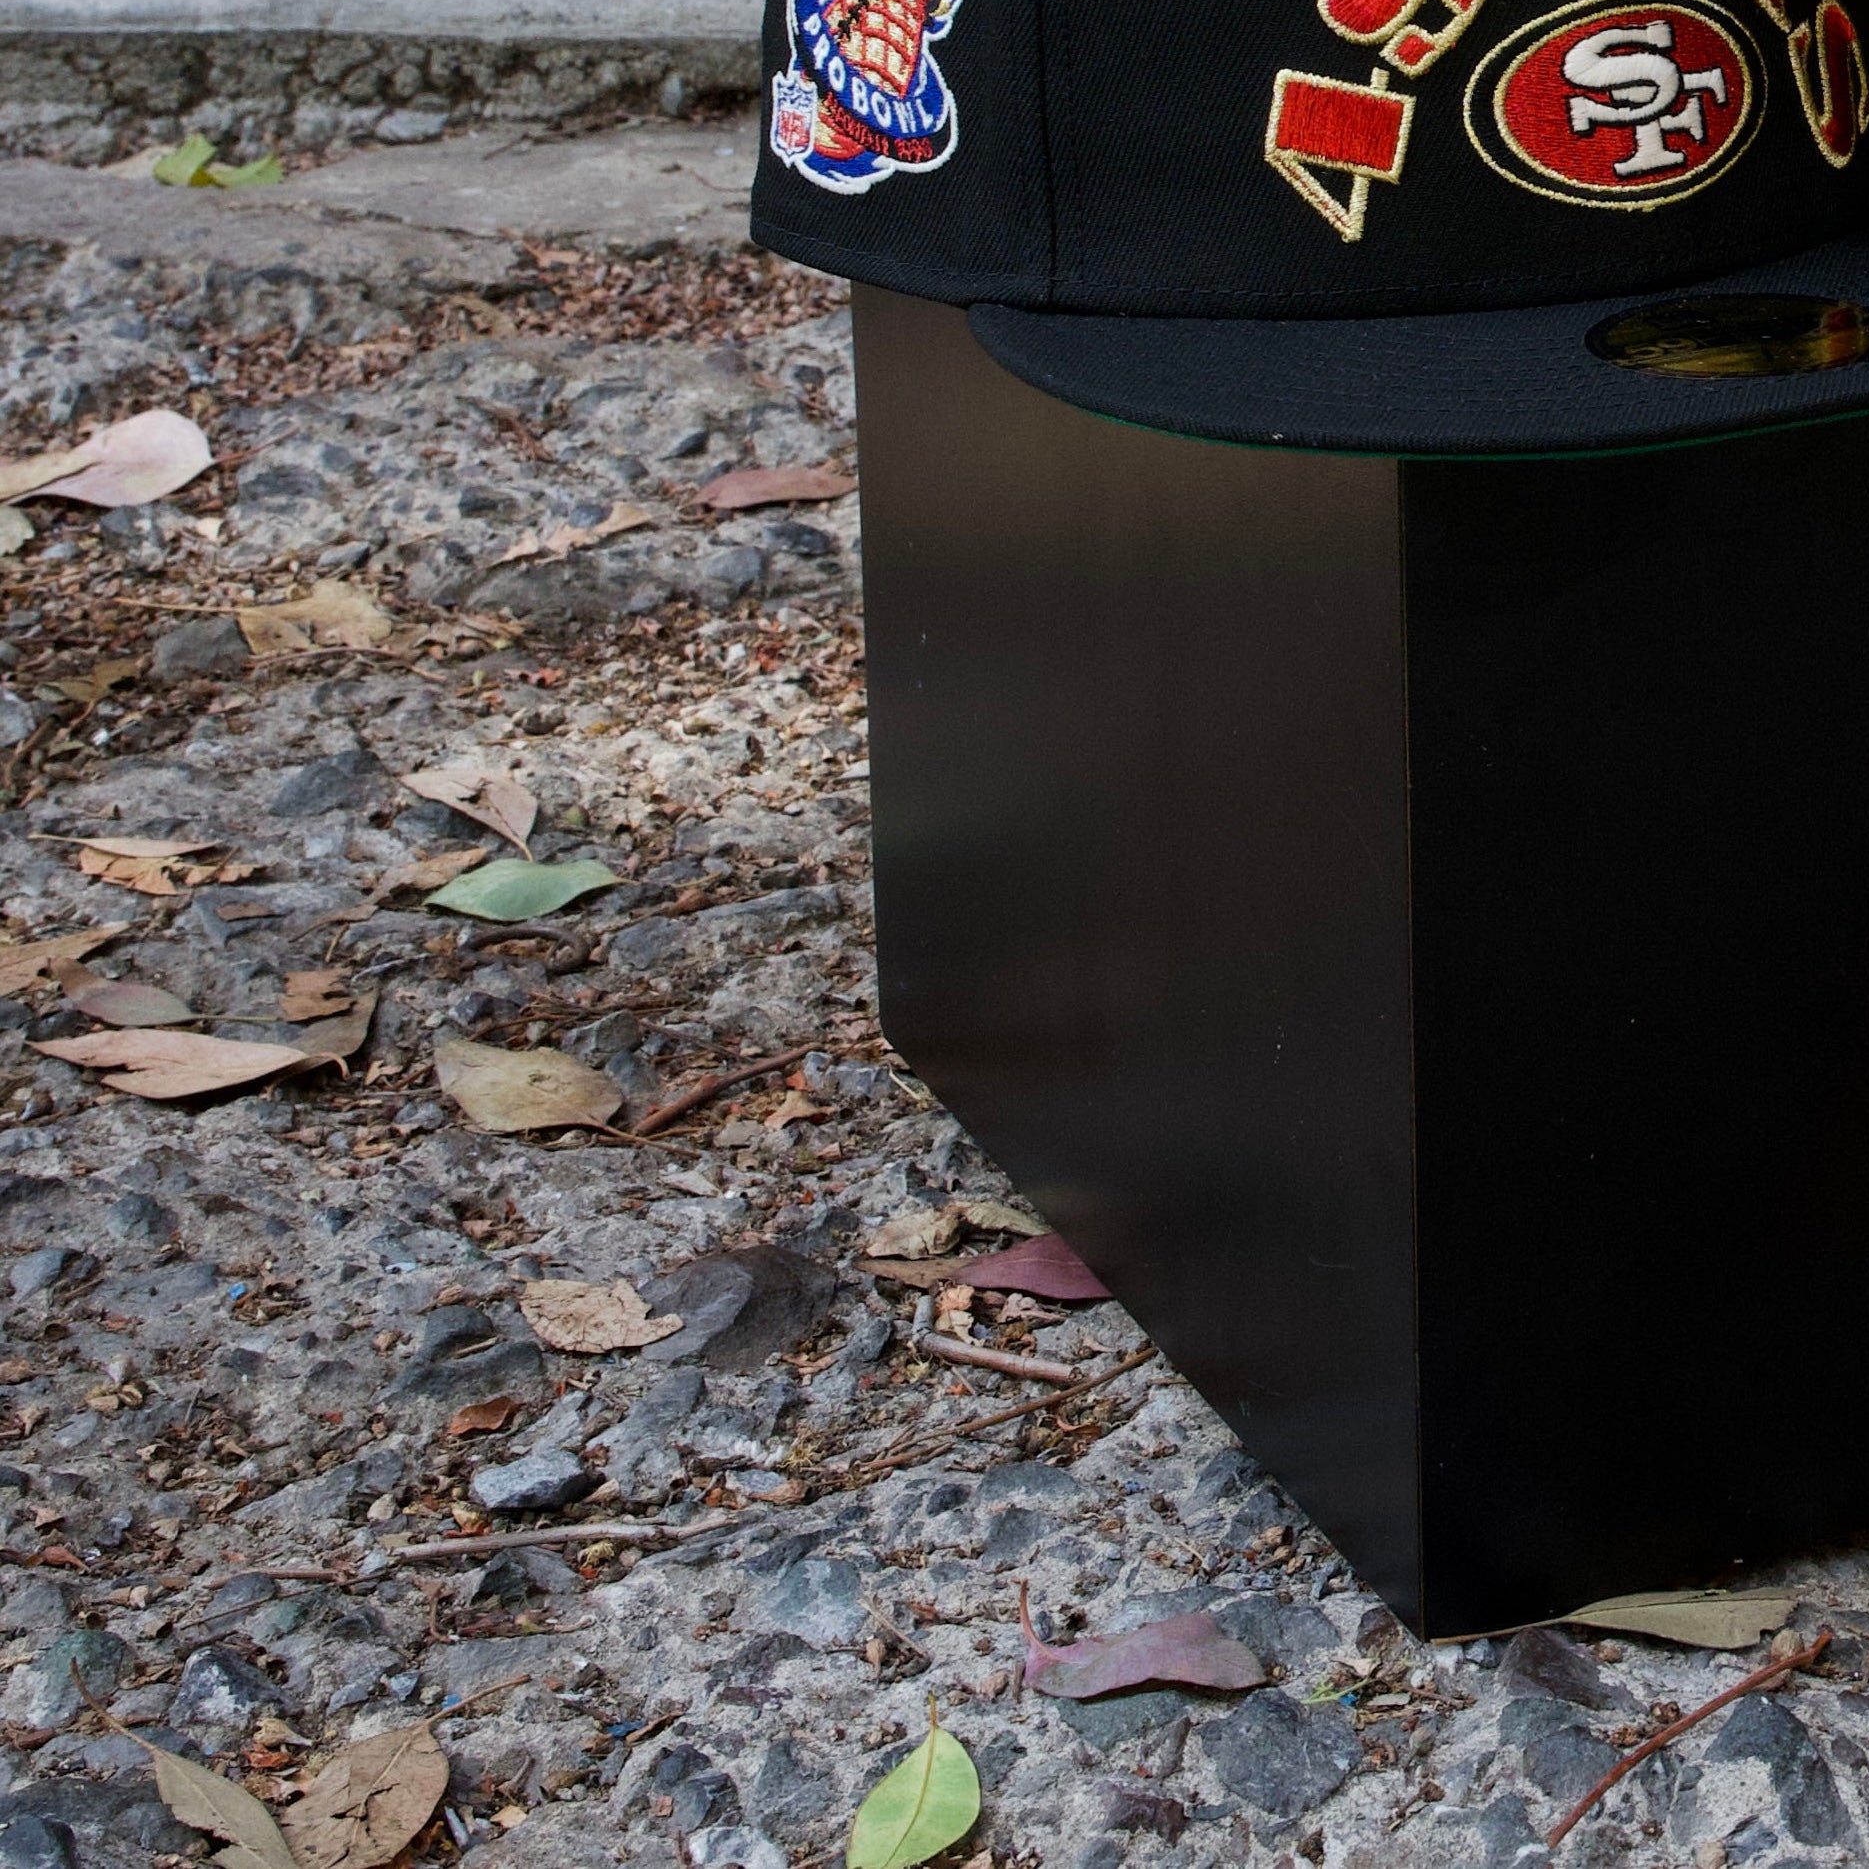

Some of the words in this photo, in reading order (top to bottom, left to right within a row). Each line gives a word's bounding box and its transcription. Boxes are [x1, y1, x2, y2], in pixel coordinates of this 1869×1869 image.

[802, 11, 847, 93] PRO
[850, 76, 935, 134] BOWL
[1562, 19, 1728, 179] SF
